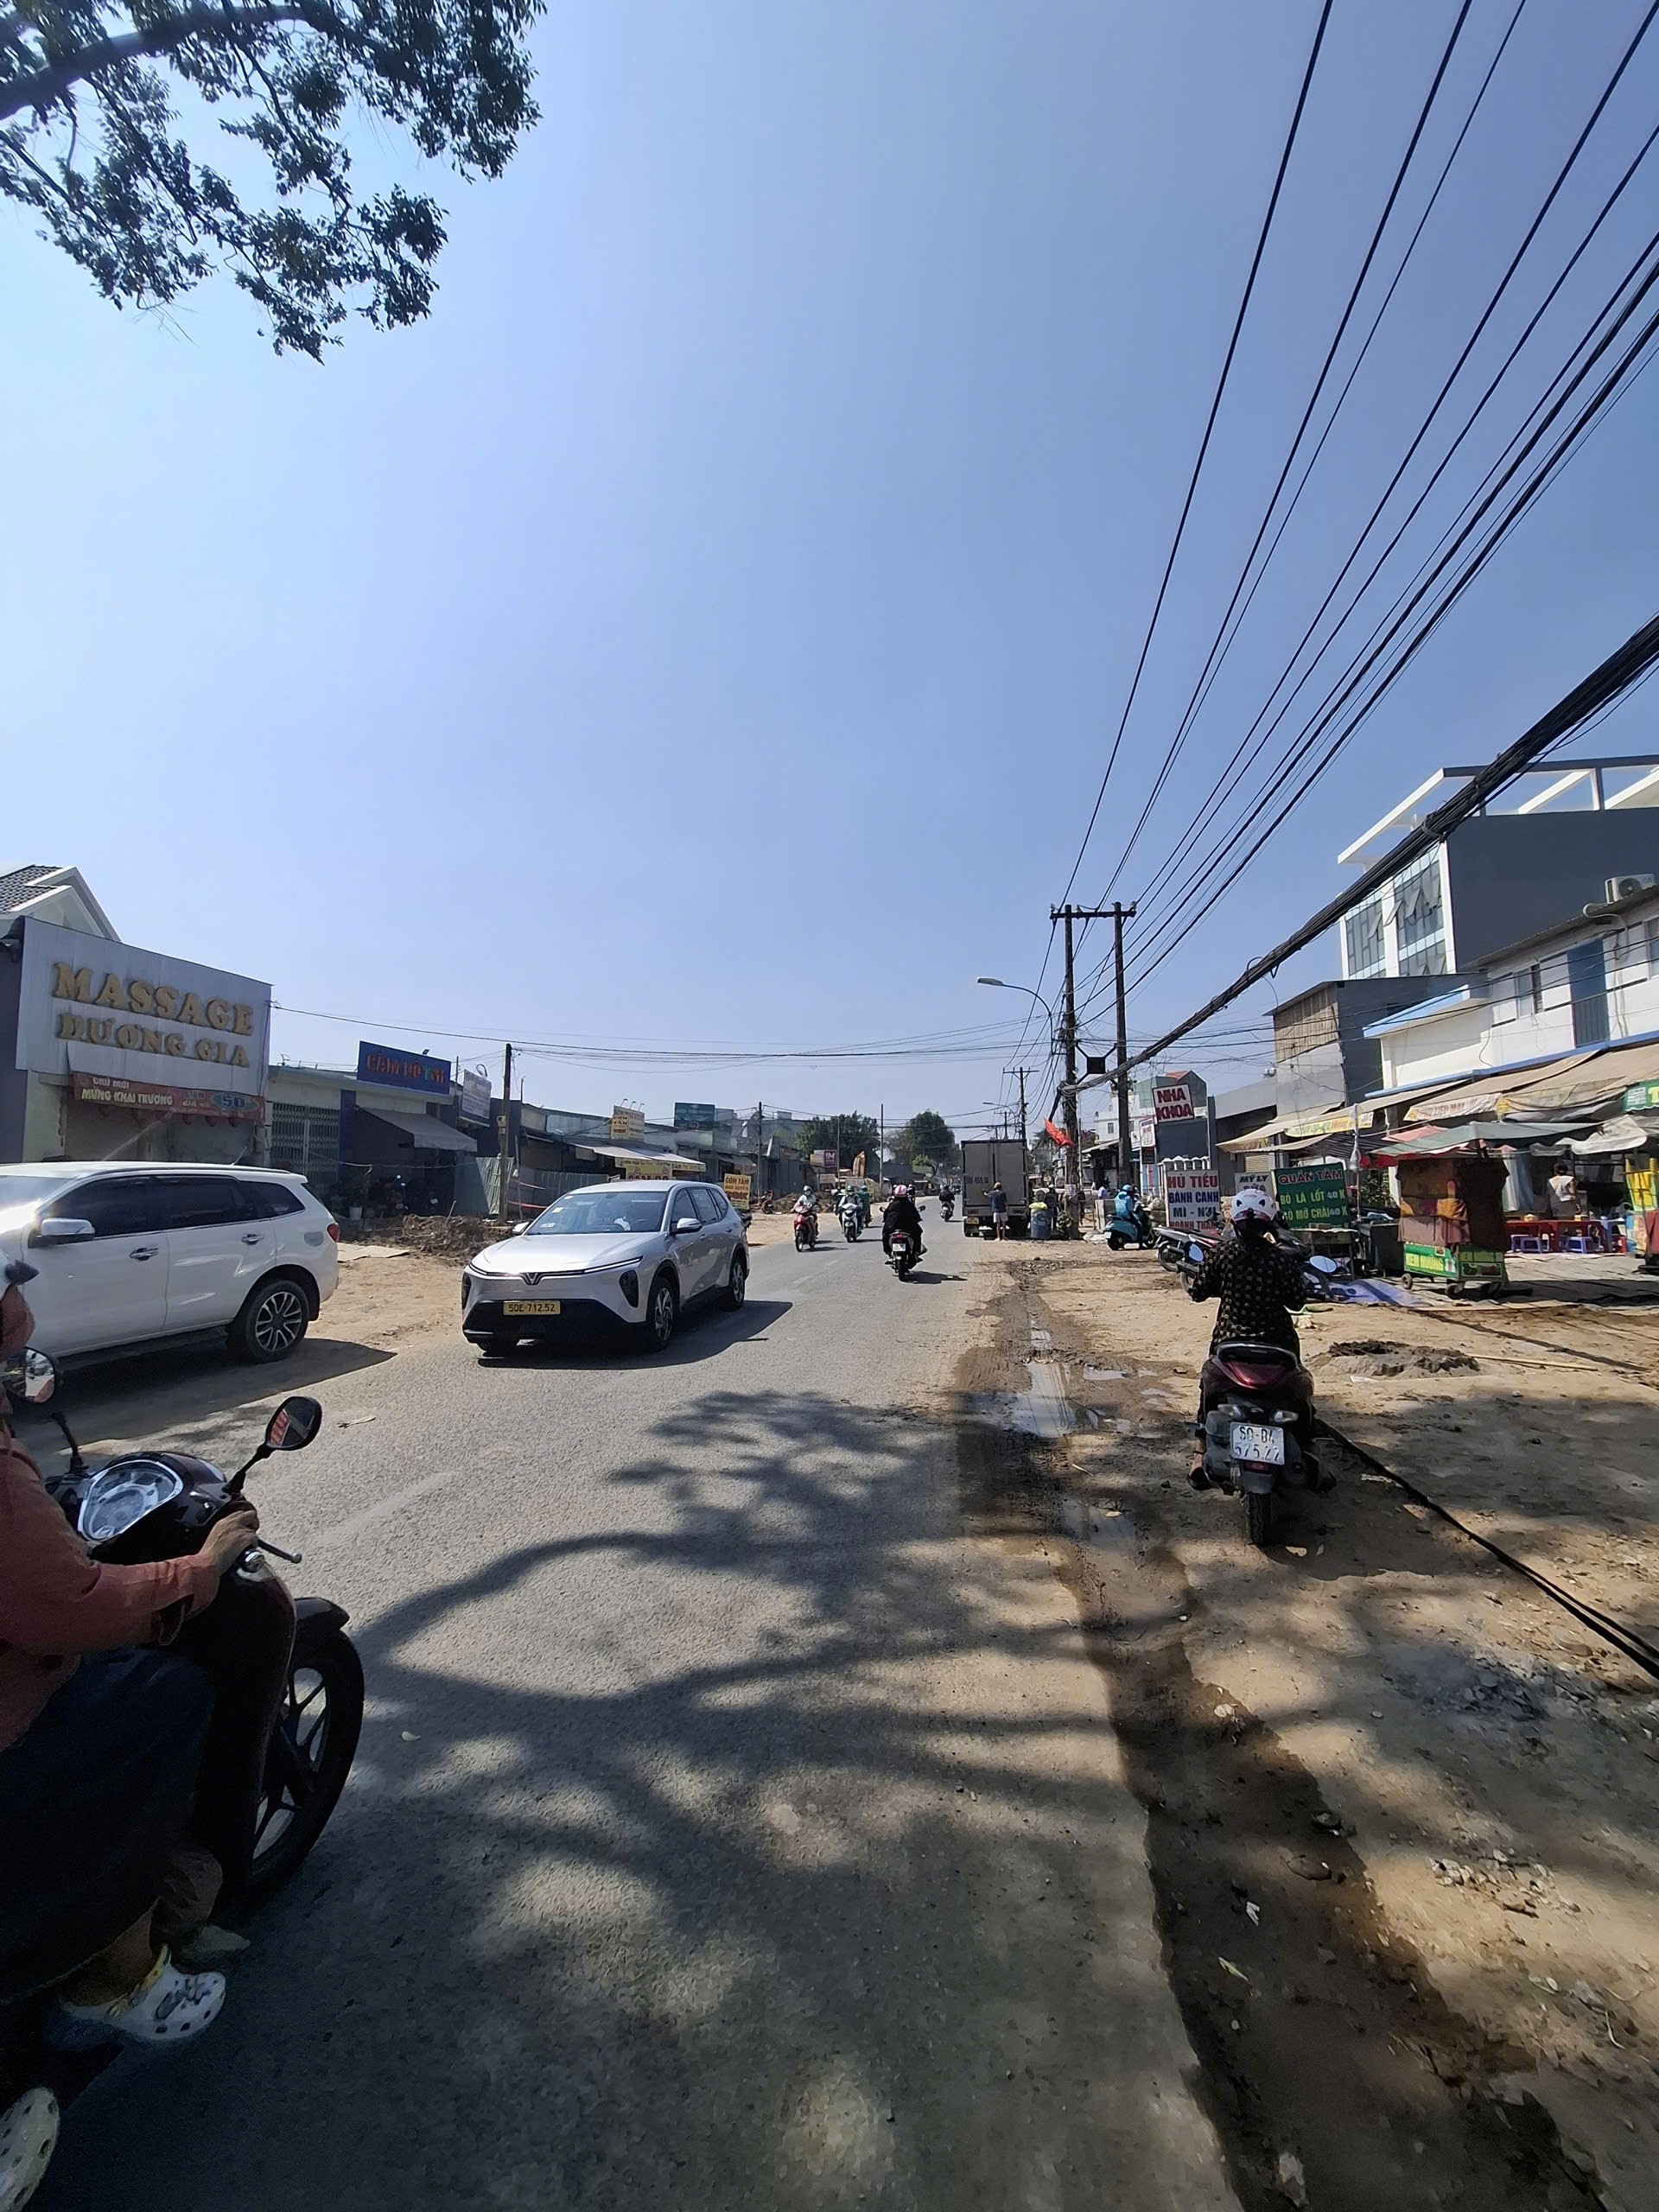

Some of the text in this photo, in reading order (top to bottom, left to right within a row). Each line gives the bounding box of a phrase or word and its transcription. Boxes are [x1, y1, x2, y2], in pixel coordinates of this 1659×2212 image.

[52, 962, 253, 1036] MASSAGE
[195, 1038, 250, 1067] GIA
[113, 1092, 136, 1103] KHAI
[137, 1092, 173, 1105] TRƯƠNG
[1157, 1088, 1186, 1103] NHA
[1156, 1104, 1192, 1120] KHOA
[1167, 1172, 1218, 1189] HỦ TIẾU
[1316, 1167, 1342, 1181] TÂM
[1169, 1190, 1219, 1204] BÁNH CANH
[1280, 1192, 1292, 1205] BÒ
[1310, 1189, 1325, 1202] LỐT
[1173, 1206, 1186, 1217] MÌ
